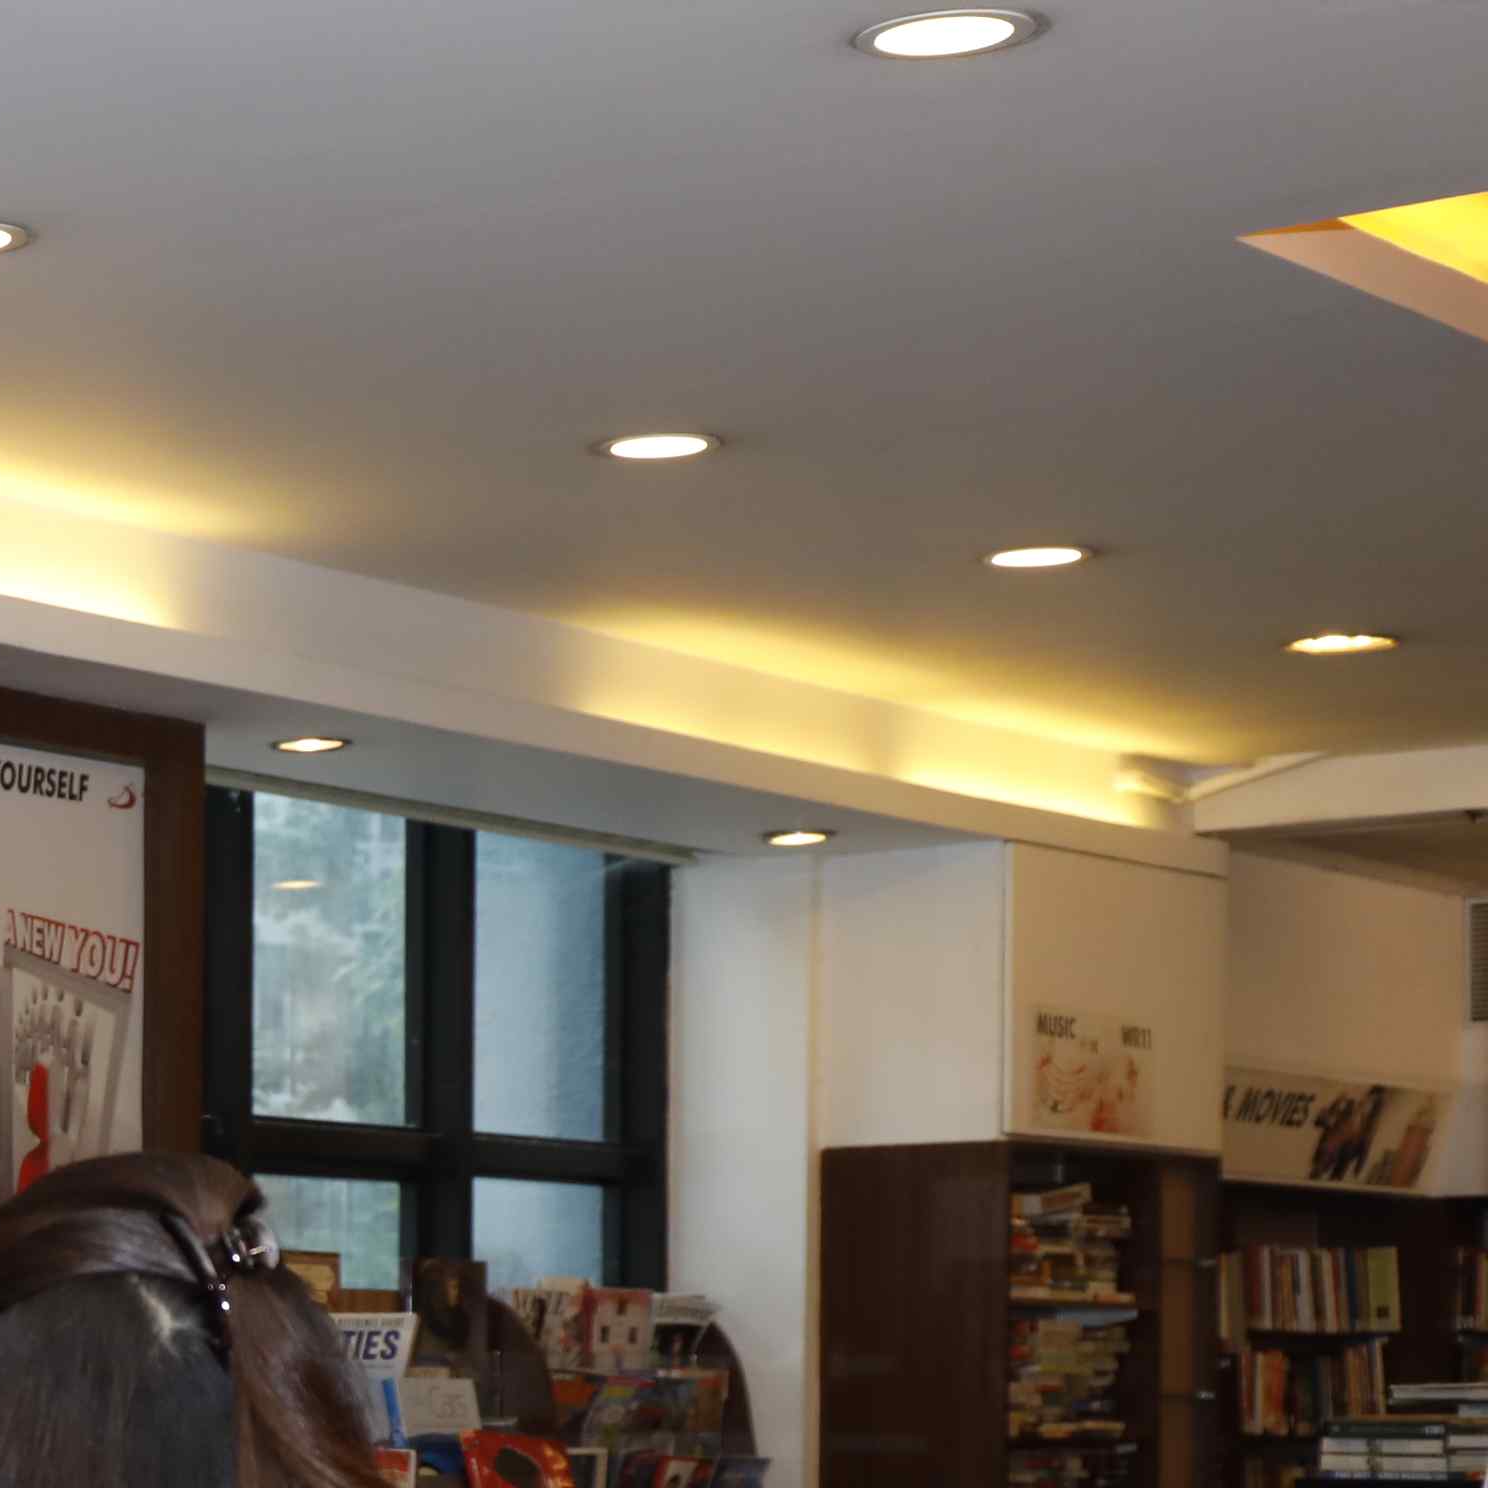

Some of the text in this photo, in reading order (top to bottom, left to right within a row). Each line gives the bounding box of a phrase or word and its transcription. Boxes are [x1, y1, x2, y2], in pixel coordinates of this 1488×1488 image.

[20, 911, 66, 966] NEW
[67, 923, 141, 993] YOU!
[1036, 1012, 1077, 1040] MUSIC
[1235, 1085, 1317, 1128] MOVIES
[342, 1329, 401, 1361] TIES
